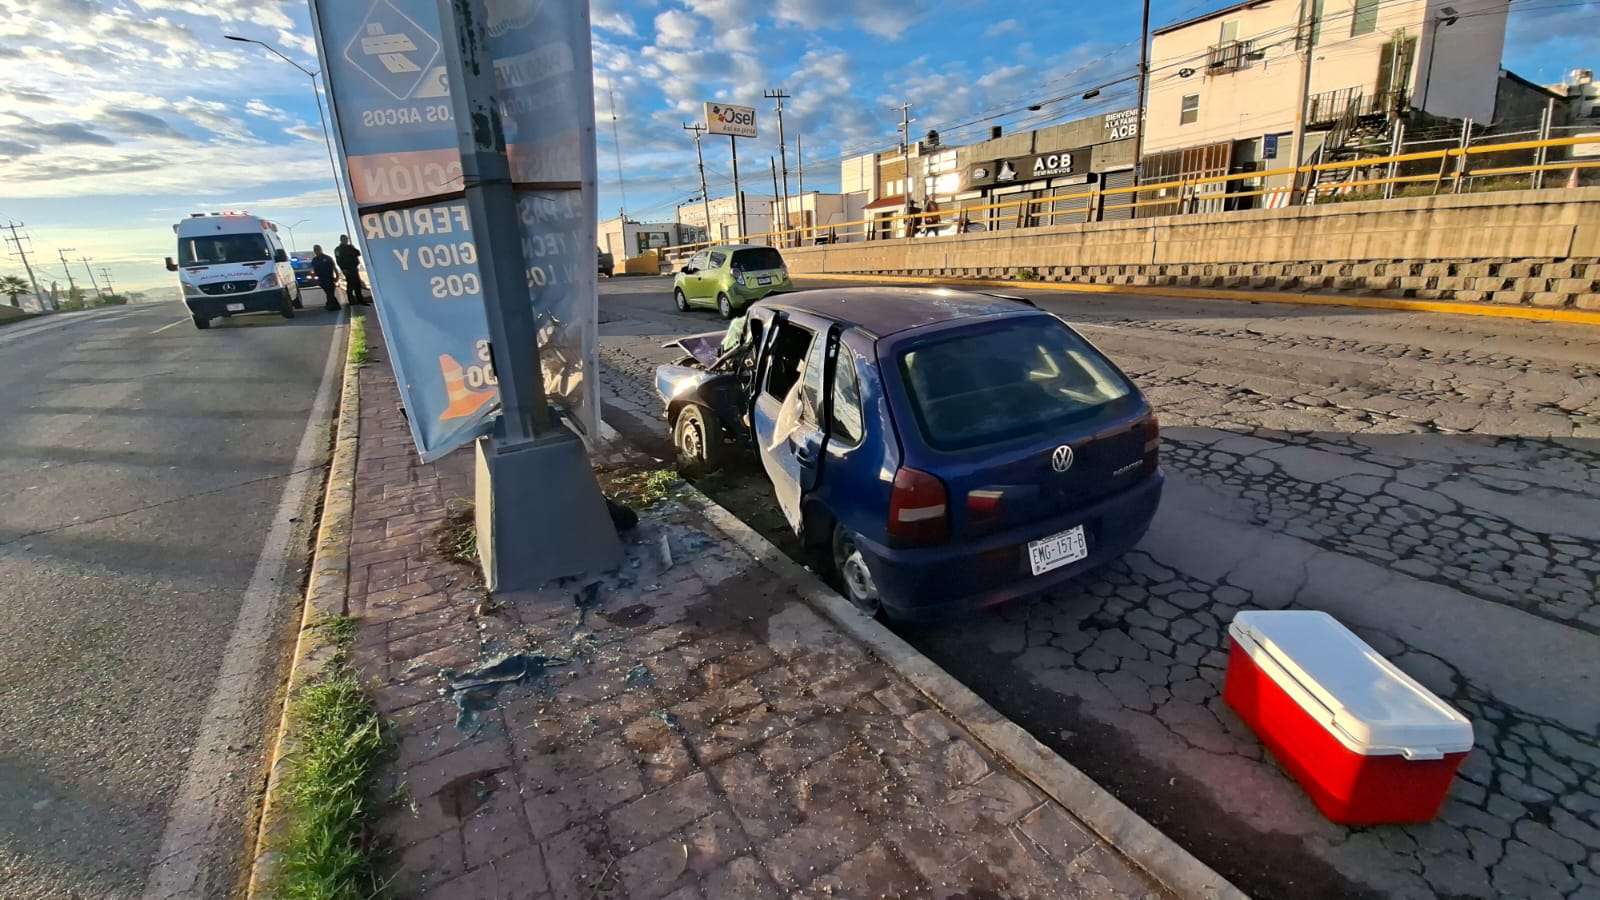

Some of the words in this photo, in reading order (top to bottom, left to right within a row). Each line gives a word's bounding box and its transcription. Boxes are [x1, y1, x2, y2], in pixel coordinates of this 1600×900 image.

[723, 107, 755, 126] Osel
[1110, 124, 1137, 140] ACB
[1034, 153, 1072, 171] ACB
[1032, 533, 1085, 565] EMG-157-B
